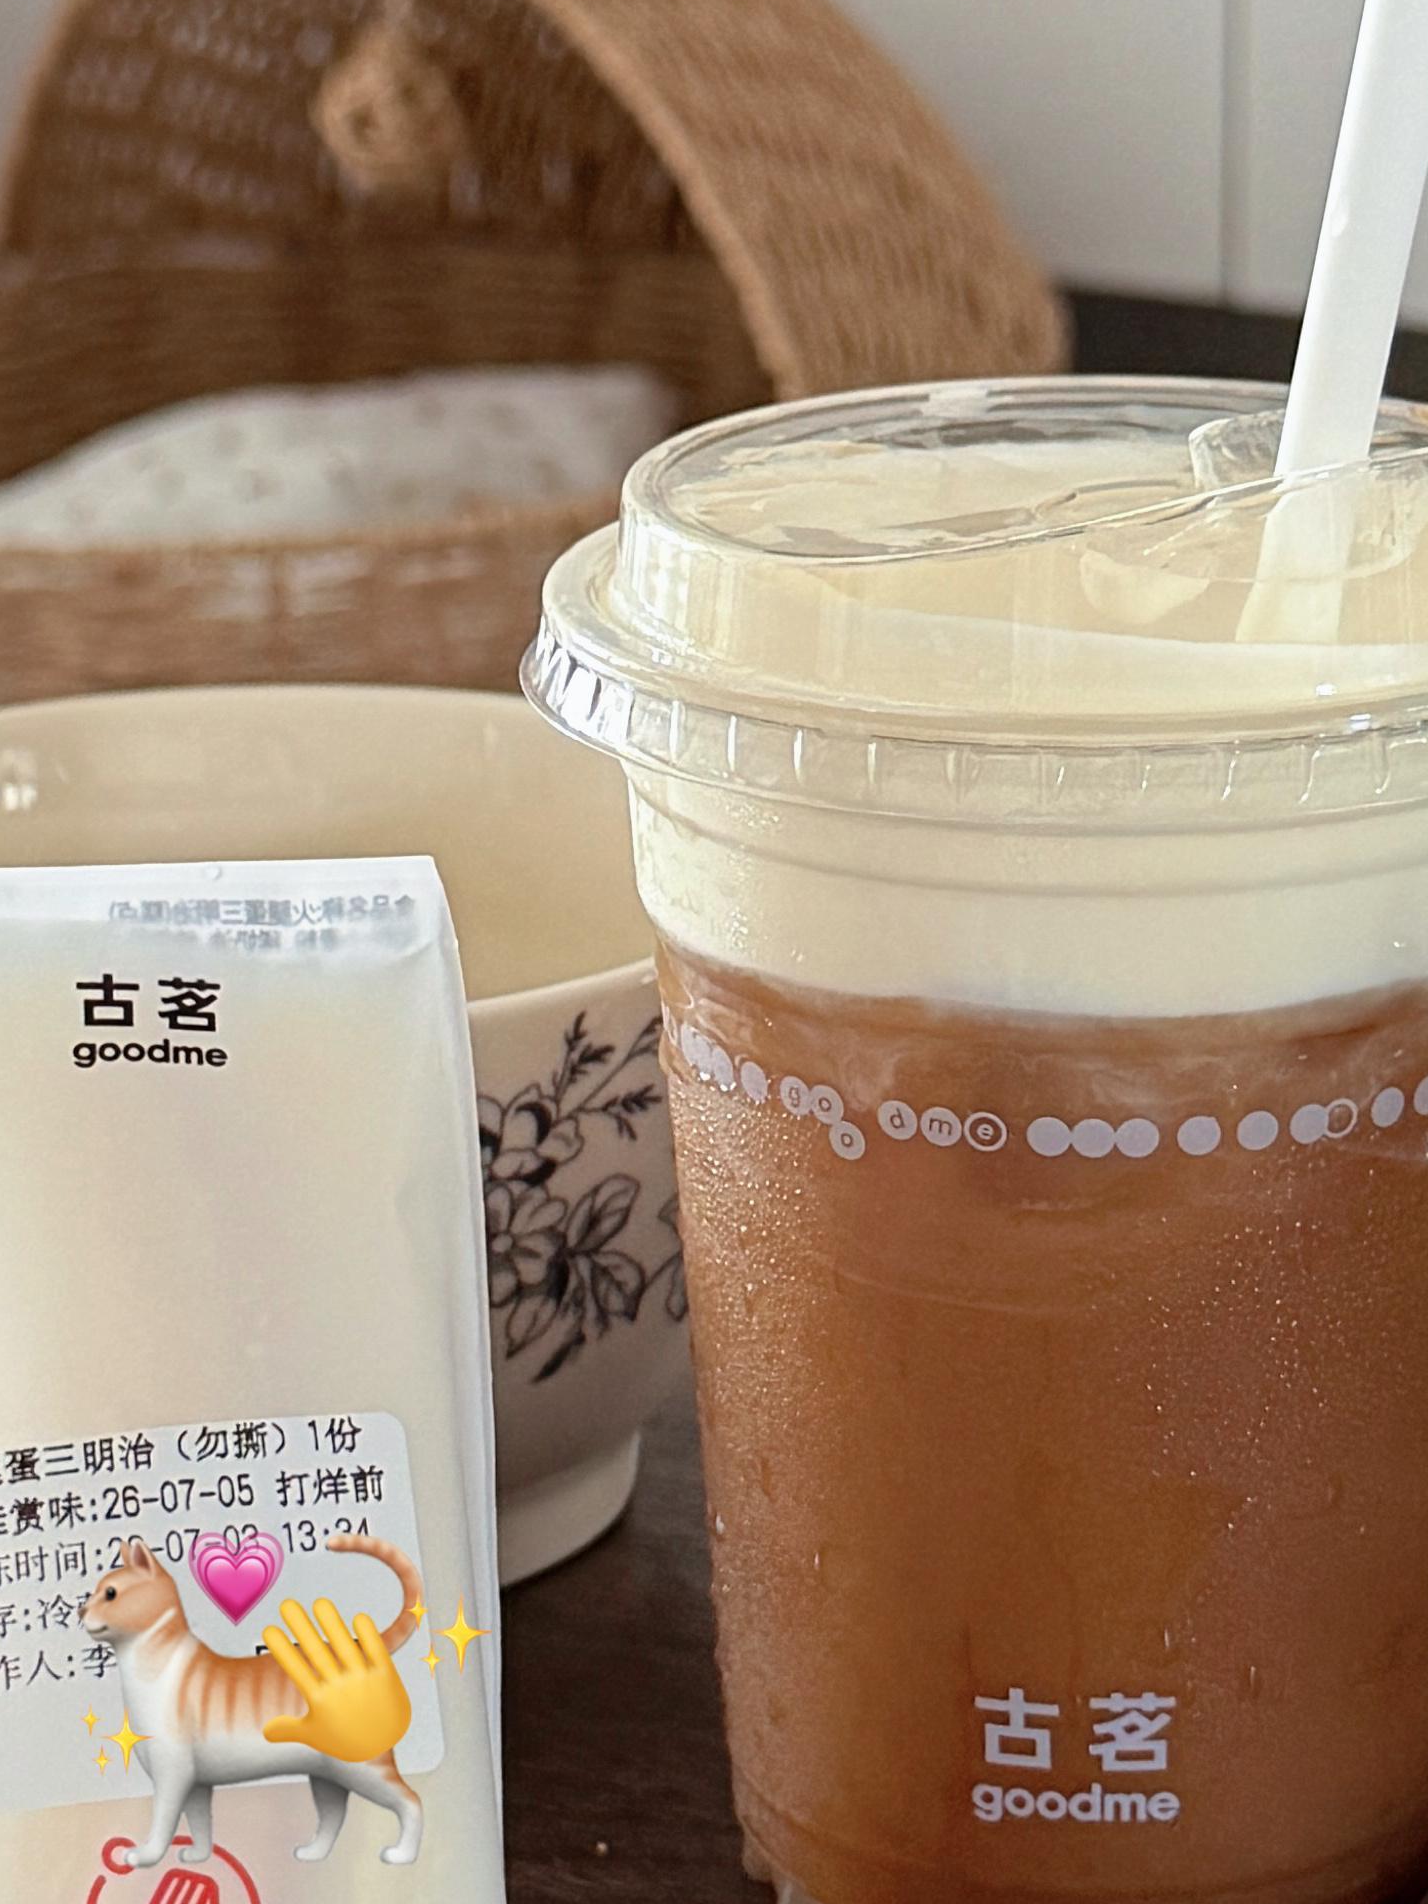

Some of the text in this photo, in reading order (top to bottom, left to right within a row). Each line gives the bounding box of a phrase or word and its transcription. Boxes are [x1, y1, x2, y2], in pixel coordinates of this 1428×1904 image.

[75, 973, 221, 1032] 古茗
[72, 1038, 228, 1069] goodme
[275, 1464, 384, 1507] 打烊前
[974, 1687, 1176, 1771] 古茗
[972, 1782, 1180, 1823] goodme
